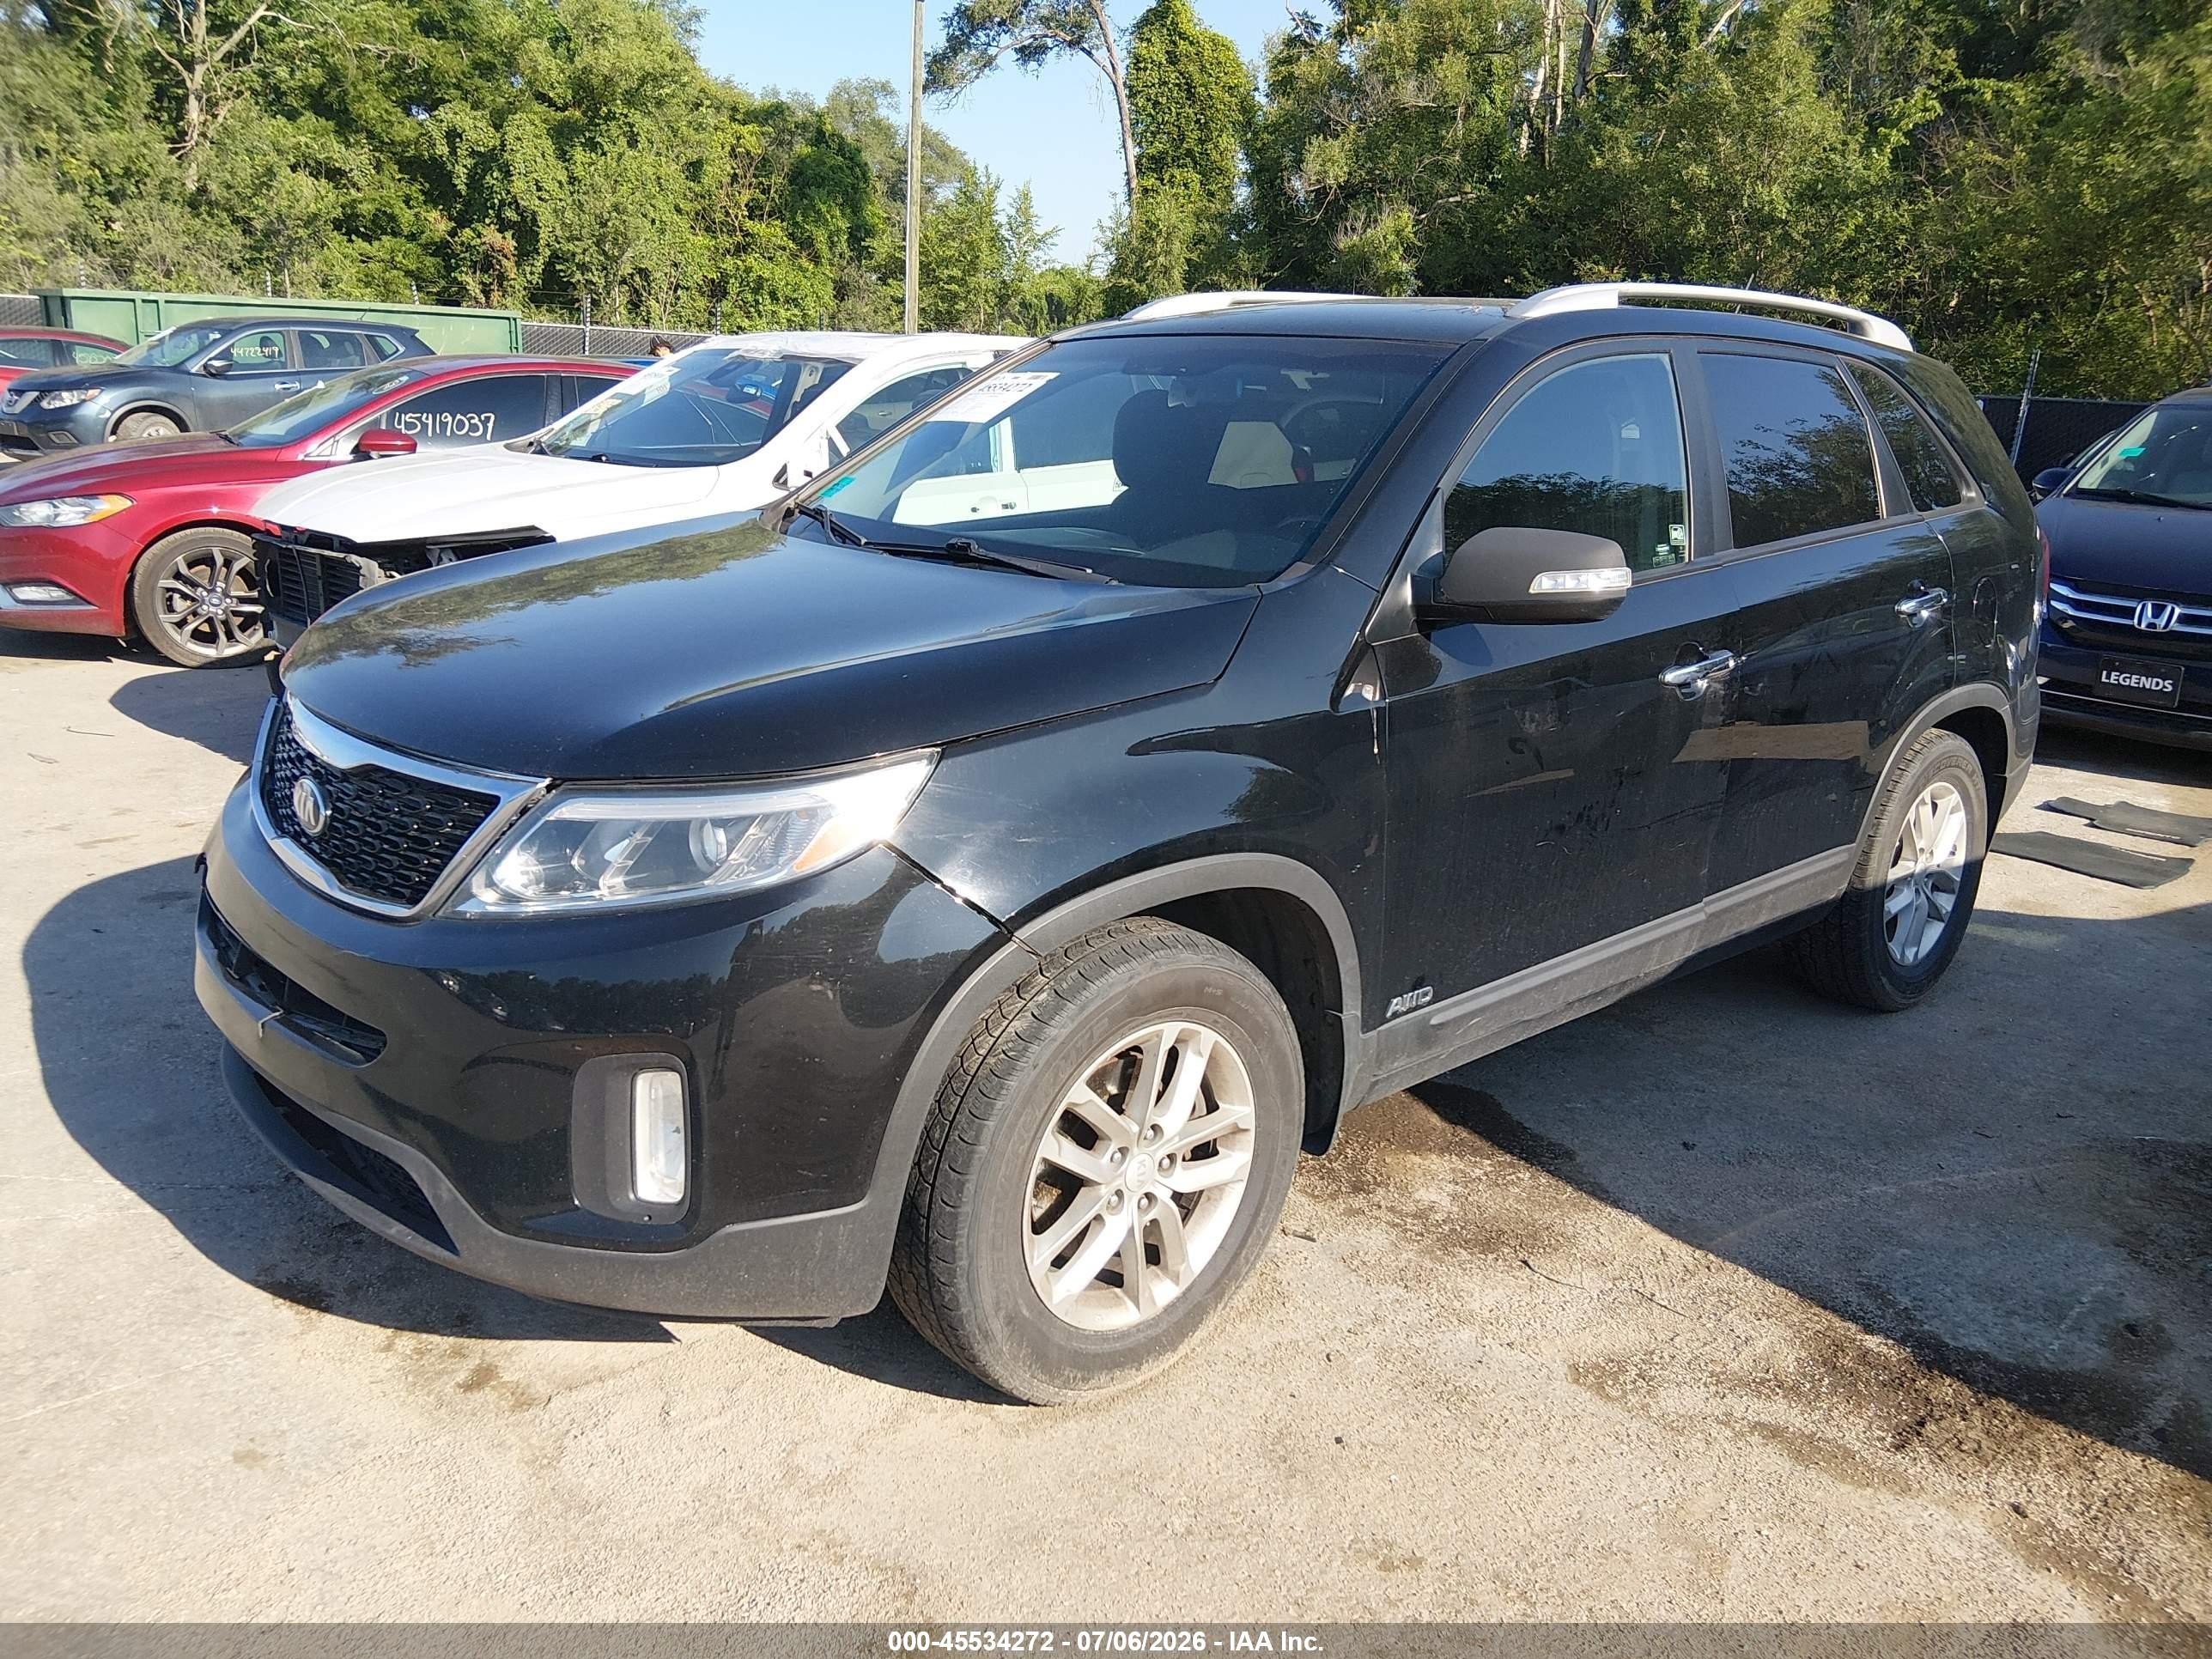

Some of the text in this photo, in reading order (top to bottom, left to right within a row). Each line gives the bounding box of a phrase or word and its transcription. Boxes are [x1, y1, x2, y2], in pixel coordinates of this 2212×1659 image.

[231, 346, 279, 358] 44722419
[394, 412, 495, 441] 45419037
[2100, 670, 2174, 692] LEGENDS
[1385, 986, 1433, 1018] AWD
